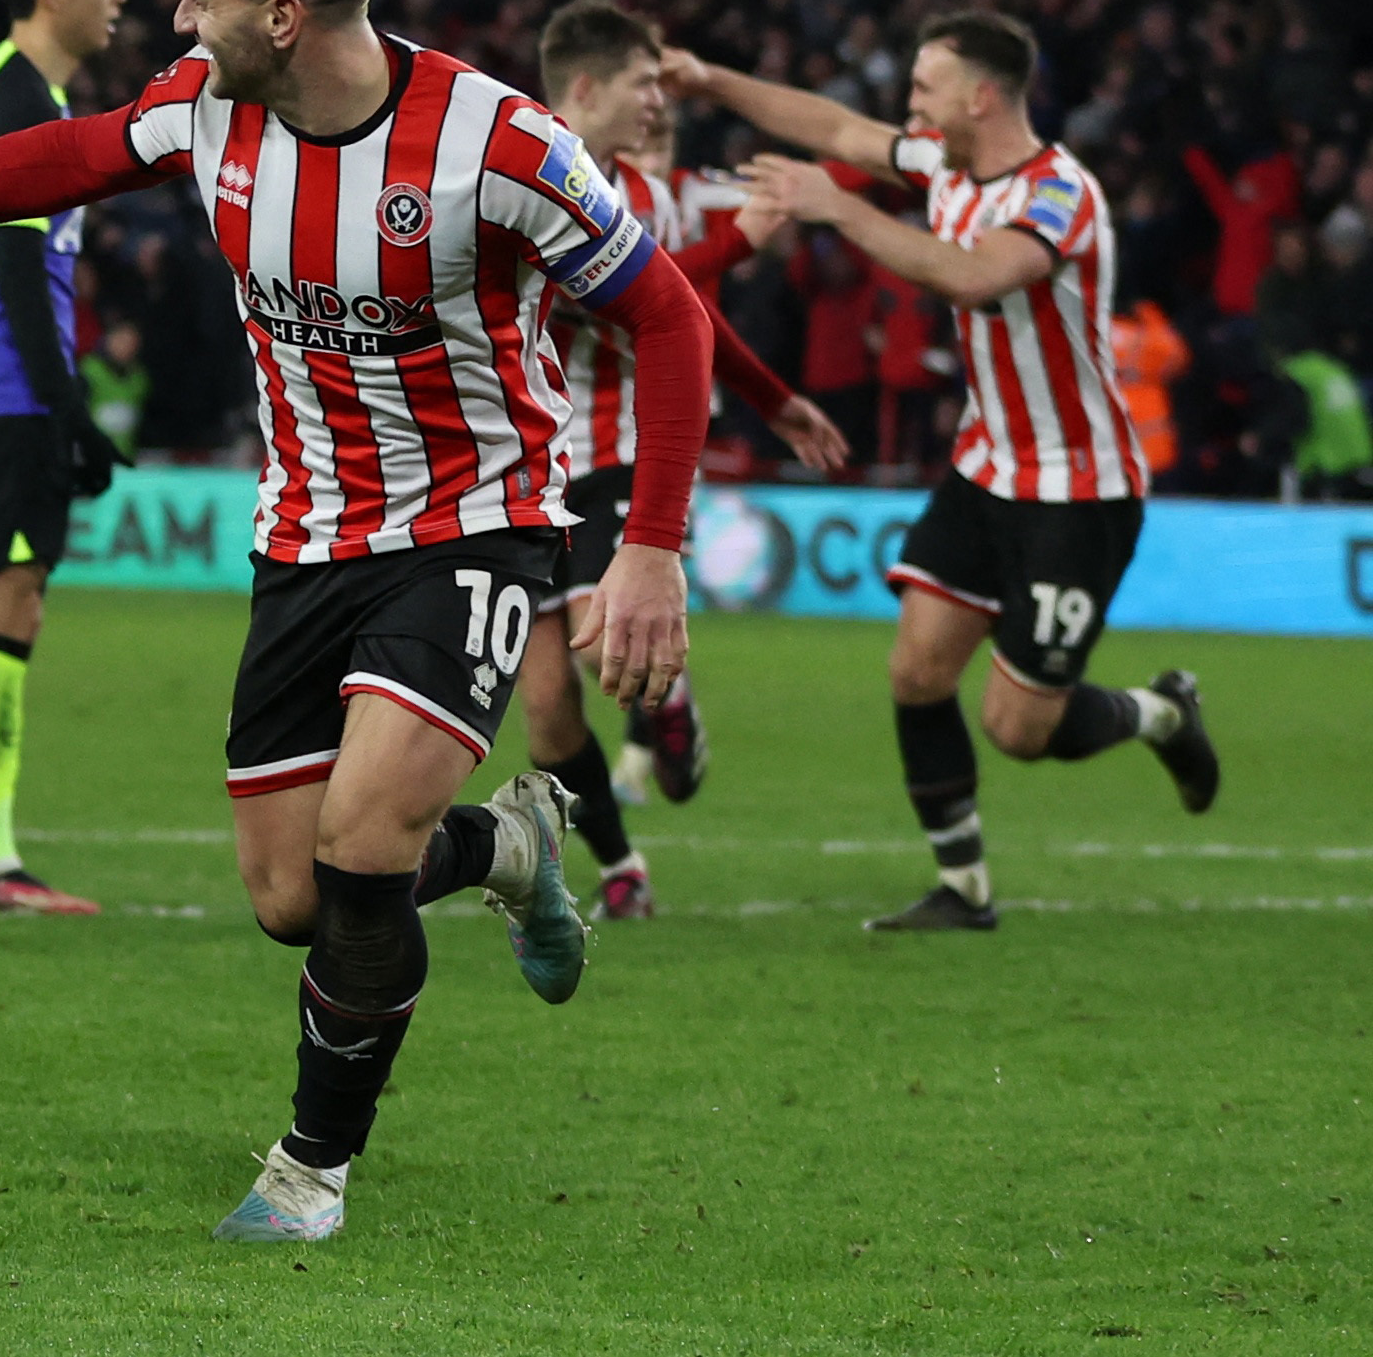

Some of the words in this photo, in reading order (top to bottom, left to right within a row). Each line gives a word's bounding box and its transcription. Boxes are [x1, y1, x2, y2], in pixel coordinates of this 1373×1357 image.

[245, 269, 440, 332] ANDOX
[584, 259, 611, 281] EFL
[271, 320, 379, 353] HEALTH
[455, 569, 530, 676] 10
[1030, 582, 1093, 647] 19
